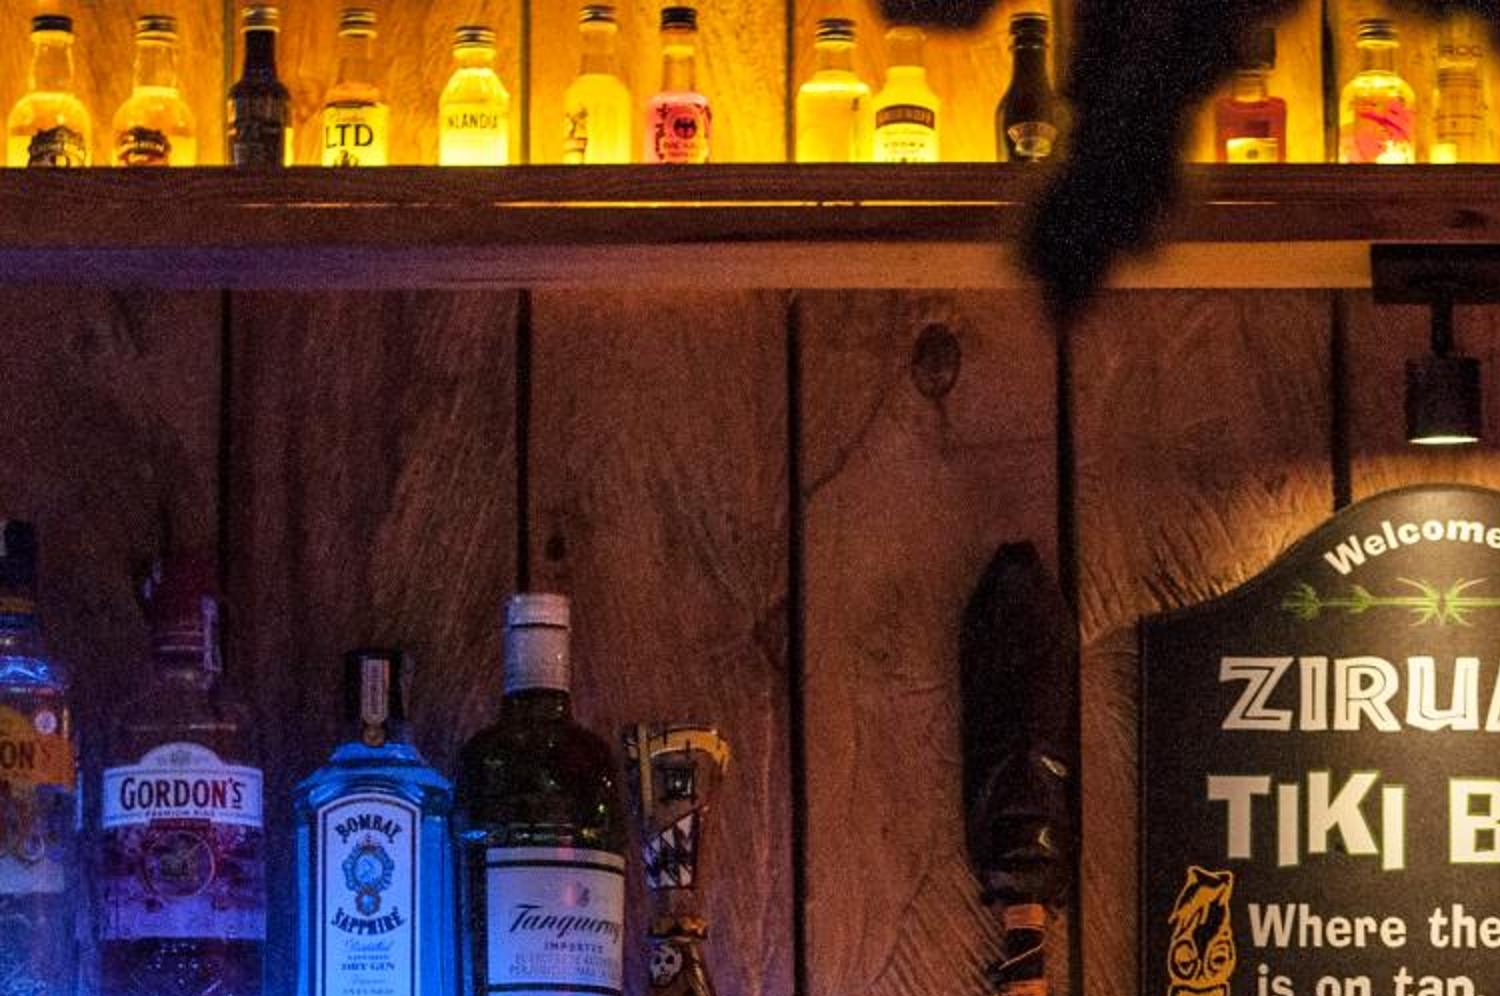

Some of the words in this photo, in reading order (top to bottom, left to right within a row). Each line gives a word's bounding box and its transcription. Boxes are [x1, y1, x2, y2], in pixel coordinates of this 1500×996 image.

[325, 123, 374, 148] LTD
[120, 777, 246, 810] GORDON'S
[335, 813, 404, 844] BOMBAY
[1207, 770, 1406, 871] TIKI
[331, 905, 406, 935] SAPPHIRE
[1248, 903, 1407, 950] Where
